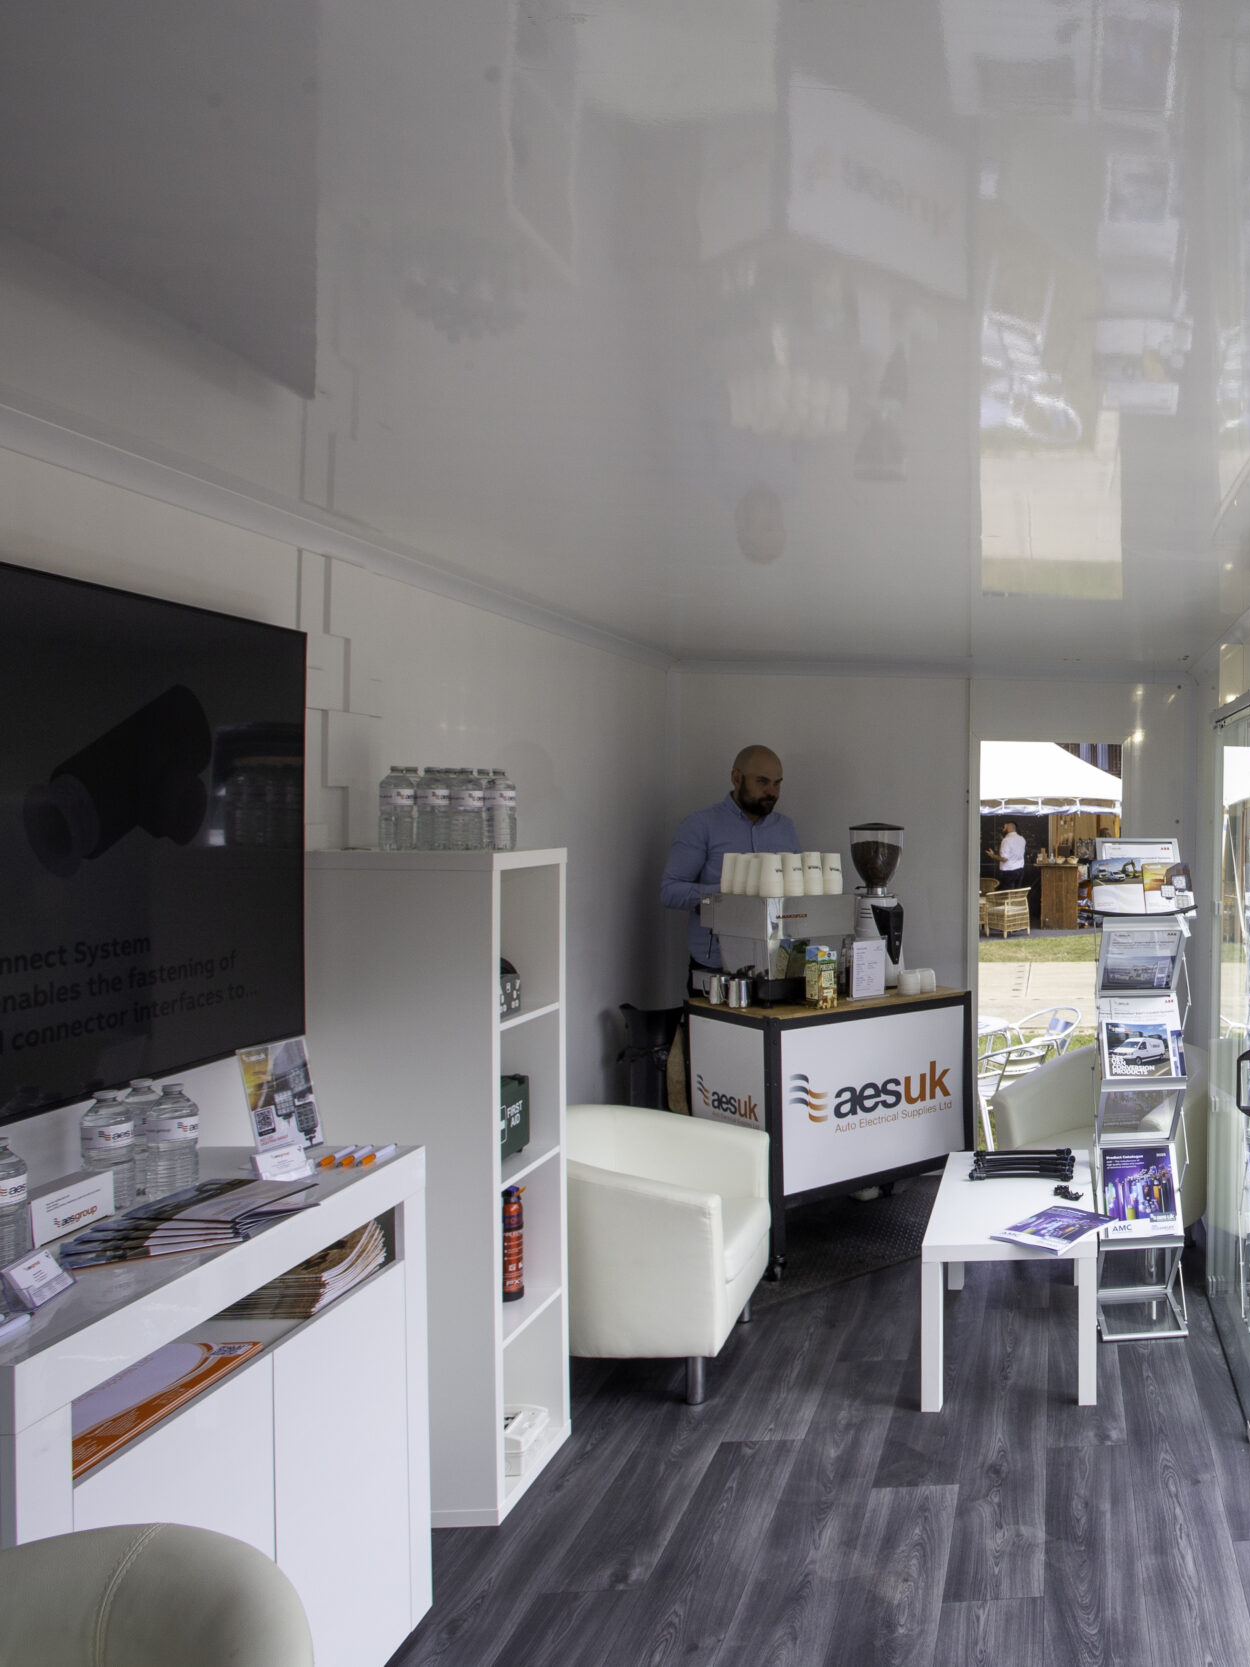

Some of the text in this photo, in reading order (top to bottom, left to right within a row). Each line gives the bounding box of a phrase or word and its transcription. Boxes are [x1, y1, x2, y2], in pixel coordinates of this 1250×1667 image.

[74, 936, 151, 968] System
[0, 949, 237, 1014] nables the fastening of
[12, 983, 258, 1051] connector interfaces to...
[834, 1061, 952, 1119] aesuk
[507, 1100, 523, 1118] FIRST
[510, 1113, 521, 1128] AID
[711, 1091, 758, 1122] aesuk
[835, 1101, 952, 1133] Auto Electrical Supplies Ltd
[61, 1205, 98, 1226] aesgroup
[1112, 1224, 1133, 1232] AMC
